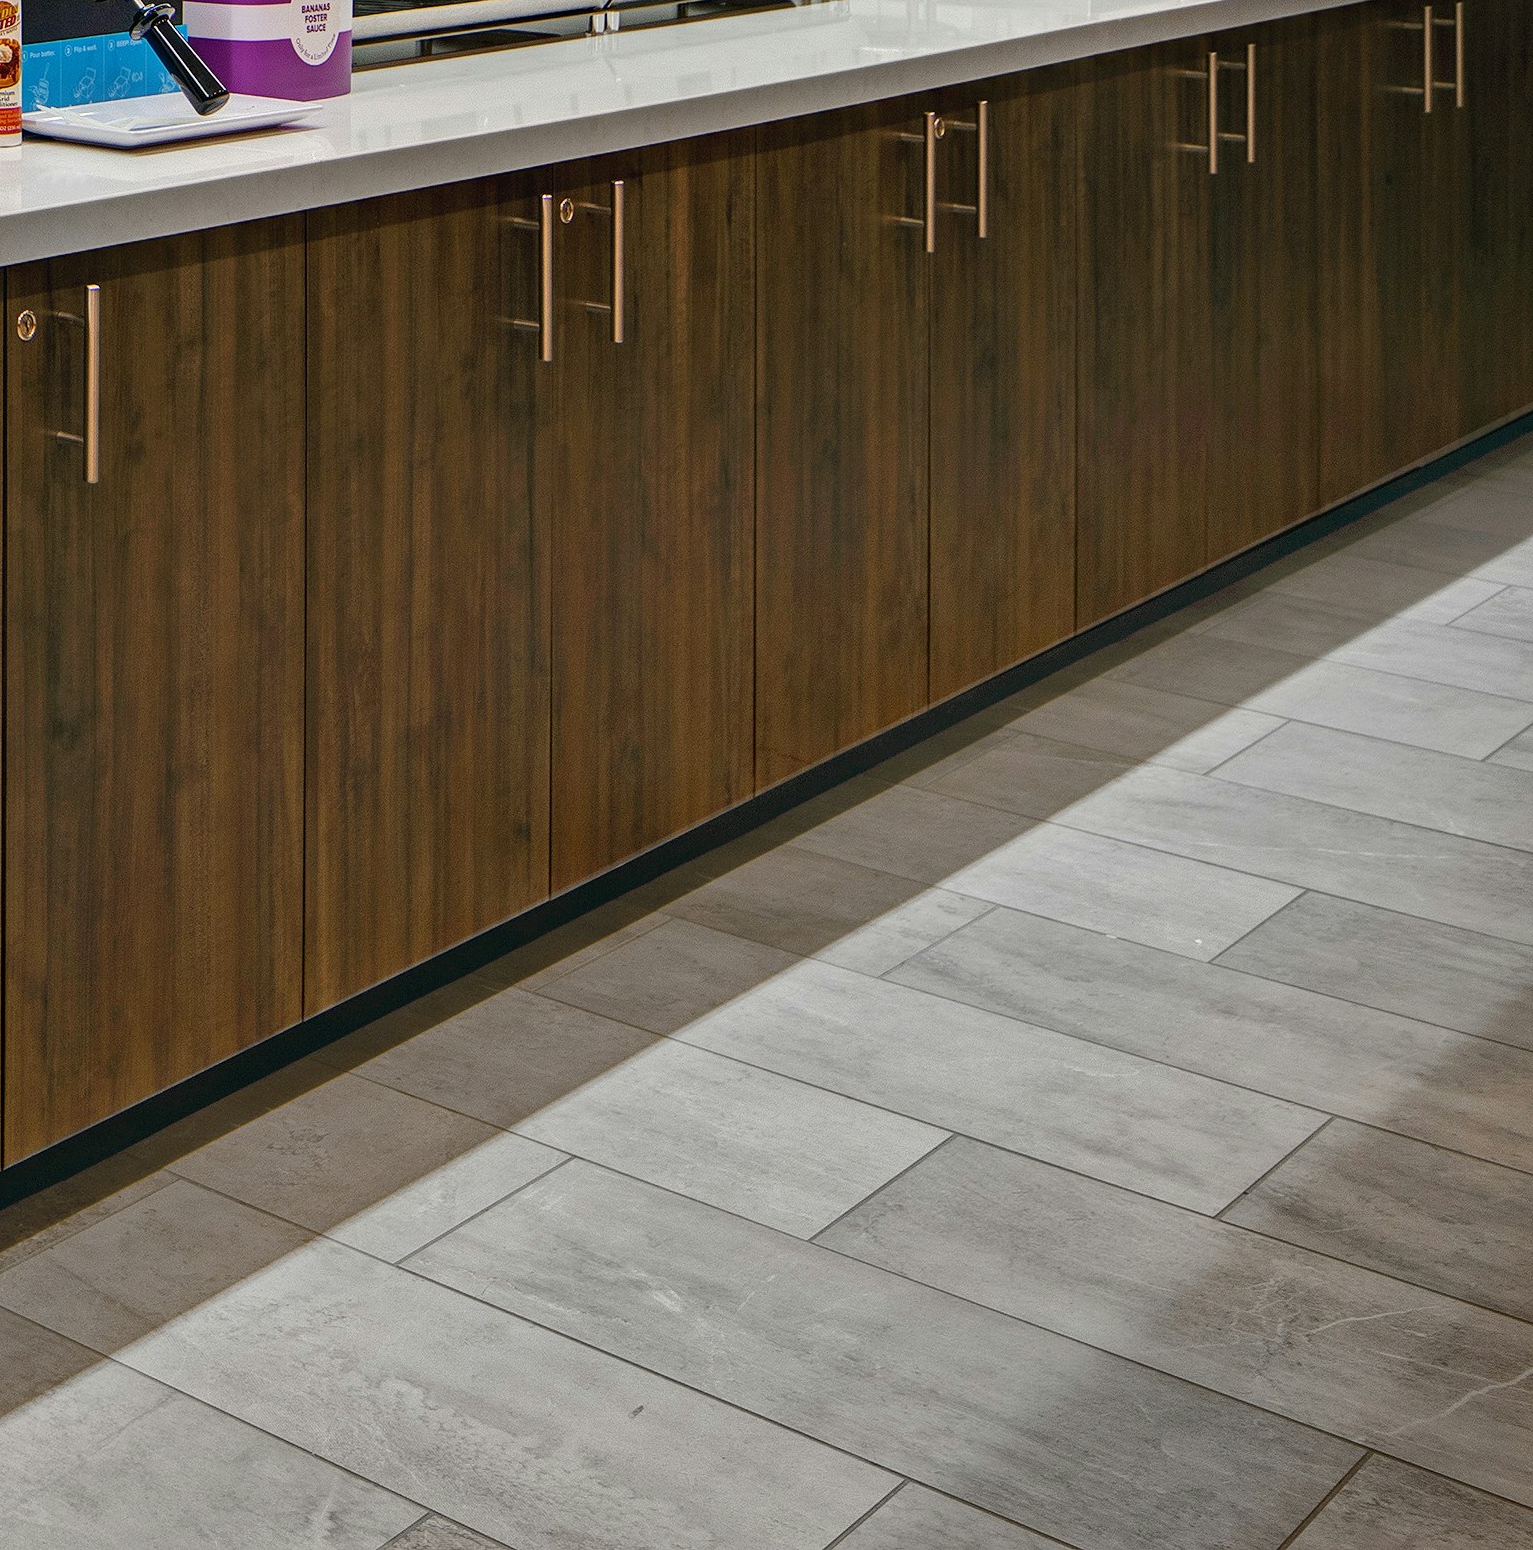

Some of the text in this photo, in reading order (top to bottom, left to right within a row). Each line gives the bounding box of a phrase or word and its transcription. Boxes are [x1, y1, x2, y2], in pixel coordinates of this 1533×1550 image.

[301, 2, 331, 14] BANANAS
[305, 13, 328, 24] FOSTER
[306, 23, 327, 34] SAUCE
